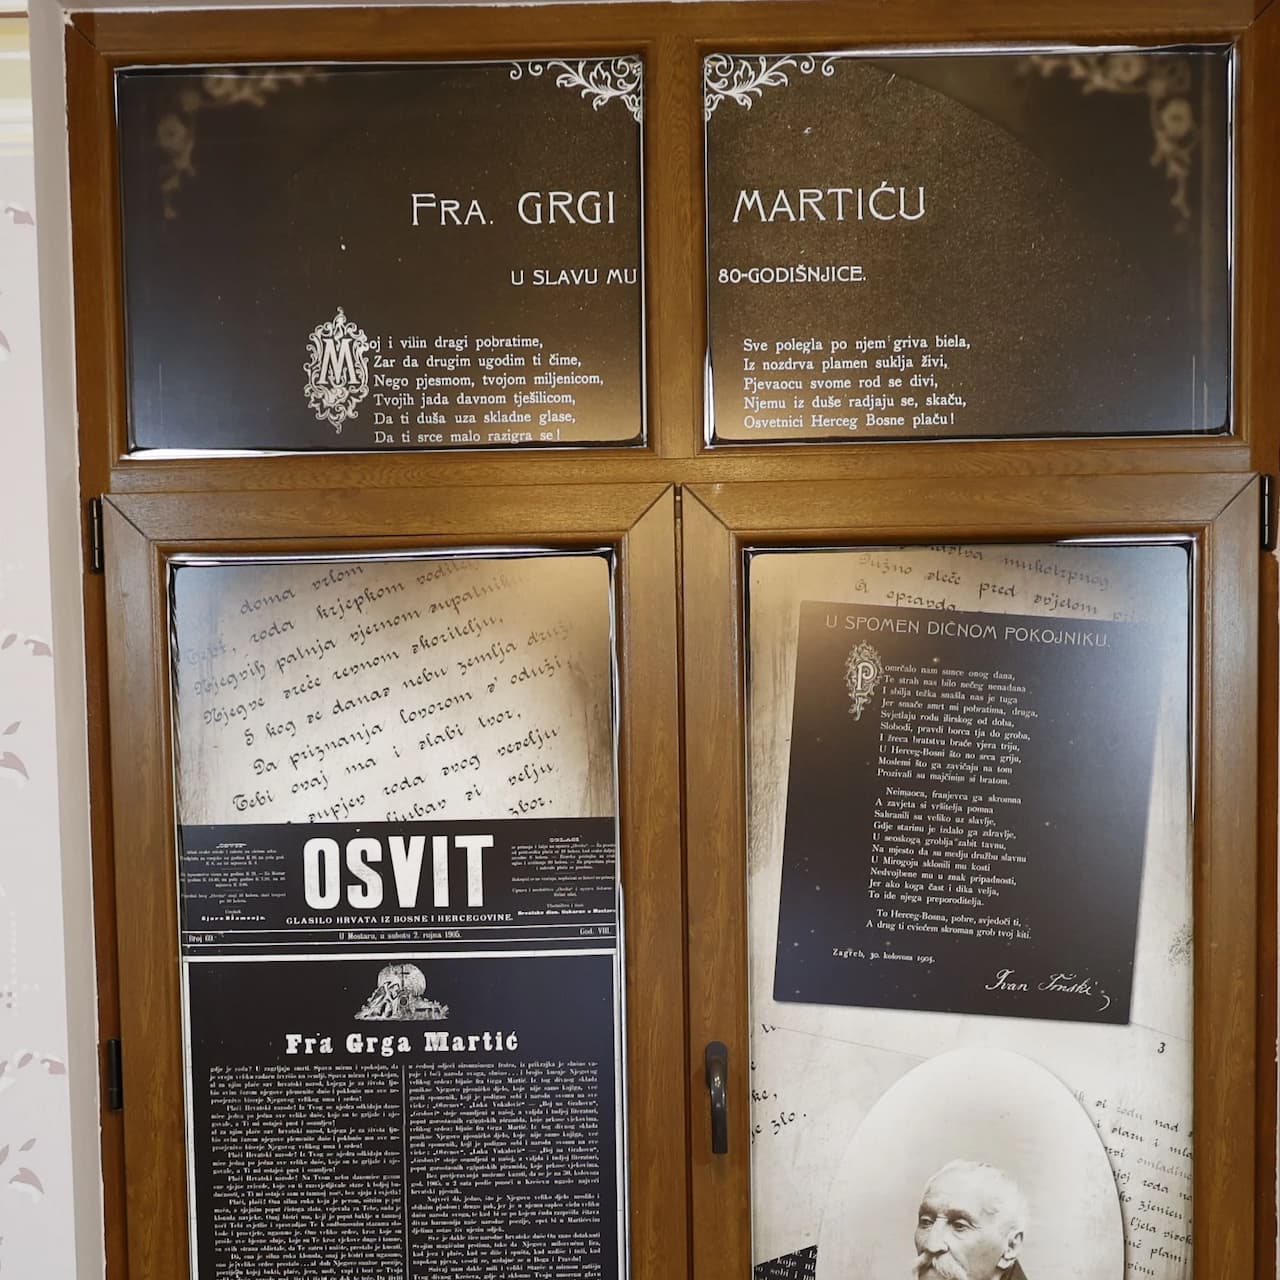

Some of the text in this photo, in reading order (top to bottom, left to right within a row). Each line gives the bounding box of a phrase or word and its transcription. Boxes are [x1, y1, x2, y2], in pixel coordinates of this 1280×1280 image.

[517, 190, 614, 224] GRGI
[732, 181, 925, 222] MARTIĆU
[511, 268, 636, 285] U SLAVU MU
[718, 264, 866, 283] 80-GODIŠNJICE.
[388, 335, 392, 348] i
[399, 335, 426, 348] vilin
[434, 334, 468, 351] dragi
[475, 334, 542, 351] pobratime,
[743, 338, 767, 351] Sve
[775, 337, 823, 354] polegla
[830, 340, 847, 353] po
[893, 335, 928, 352] griva
[935, 335, 970, 349] biela,
[373, 352, 581, 370] Zar da drugim ugodim ti čime,
[743, 354, 947, 373] Iz nozdrva plamen suklja živi,
[373, 371, 603, 390] Nego pjesmom, tvojom miljenicom,
[743, 373, 938, 393] Pjevaocu svome rod se divi,
[372, 391, 575, 409] Tvojih jada davnom tješilicom,
[743, 392, 966, 413] Njemu iz duše radjaju se, skaču,
[373, 409, 575, 425] Da ti duša uza skladne glase,
[744, 415, 803, 428] Osvetnici
[811, 414, 858, 430] Herceg
[865, 413, 904, 426] Bosne
[374, 430, 394, 443] Da
[401, 430, 410, 442] ti
[417, 433, 442, 442] srce
[450, 429, 480, 442] malo
[488, 428, 533, 443] razigra
[826, 615, 1111, 648] U SPOMEN DIČNOM POKOJNIKU.
[303, 834, 493, 908] OSVIT
[285, 913, 513, 924] GLASILO HRVATA IZ BOSNE I HERCEGOVINE.
[285, 1031, 517, 1057] Fra Grga Martić
